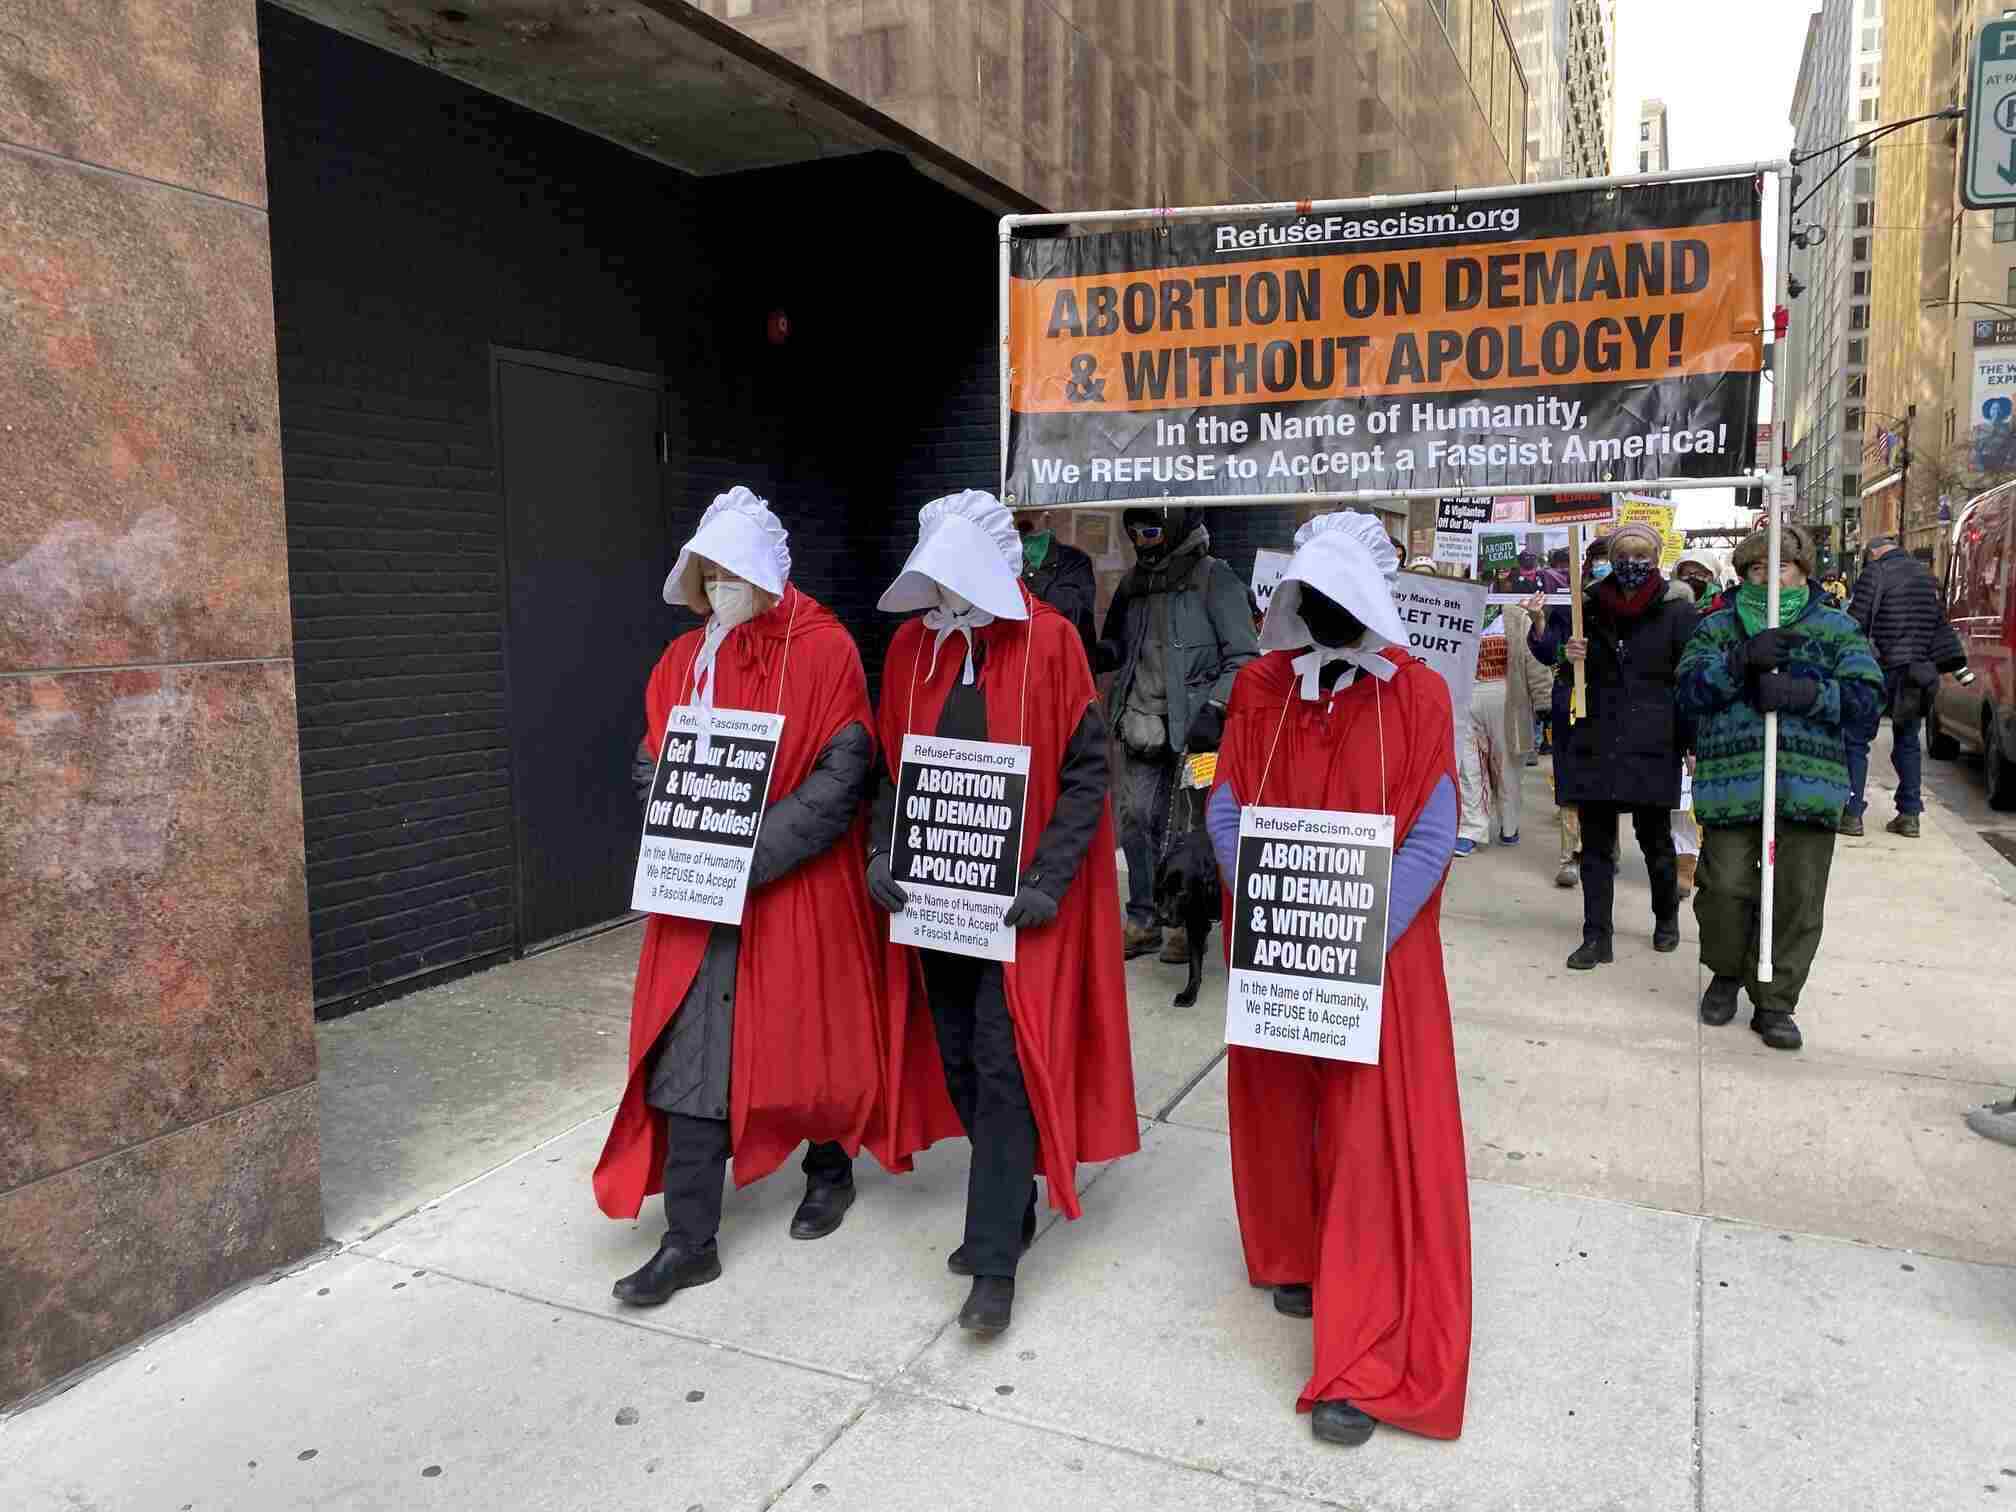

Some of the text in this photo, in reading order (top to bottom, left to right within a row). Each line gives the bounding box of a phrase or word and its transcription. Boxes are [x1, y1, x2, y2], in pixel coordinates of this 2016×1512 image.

[1216, 206, 1520, 248] RefuseFascism.org
[1047, 238, 1710, 338] ABORTION ON DEMAND
[1066, 312, 1686, 402] & WITHOUT APOLOGY!
[1156, 396, 1588, 446] In the Name of Humanity,
[1032, 458, 1080, 484] We
[1091, 451, 1216, 484] REFUSE
[1226, 451, 1259, 480] to
[1268, 446, 1385, 481] Accept
[1396, 452, 1415, 471] a
[1428, 437, 1553, 469] Fascist
[1562, 424, 1727, 464] America!
[1410, 593, 1441, 608] March
[1444, 599, 1461, 610] 8th
[1437, 615, 1475, 633] THE
[1409, 633, 1462, 654] OURT
[667, 738, 693, 763] Get
[725, 743, 767, 771] Laws
[914, 744, 1016, 768] RefuseFascism.org
[666, 770, 752, 803] & Vigilantes
[916, 767, 1006, 800] ABORTION
[649, 799, 758, 837] Off Our Bodies!
[906, 796, 1012, 830] ON DEMAND
[1255, 817, 1377, 840] RefuseFascism.org
[653, 848, 667, 862] the
[668, 849, 693, 865] Name
[693, 852, 703, 865] of
[908, 825, 1006, 860] & WITHOUT
[1259, 842, 1366, 876] ABORTION
[647, 864, 737, 889] We REFUSE to Accept
[909, 855, 997, 889] APOLOGY!
[651, 886, 724, 907] a Fascist America
[924, 895, 949, 909] Name
[952, 898, 961, 910] of
[1248, 873, 1374, 910] ON DEMAND
[905, 907, 999, 934] We REFUSE to Accept
[913, 925, 989, 947] a Fascist America
[1251, 906, 1367, 943] & WITHOUT
[1253, 939, 1357, 976] APOLOGY!
[1240, 979, 1369, 1011] In the Name of Humanity,
[1246, 999, 1360, 1029] We REFUSE to Accept
[1255, 1022, 1347, 1047] a Fascist America
